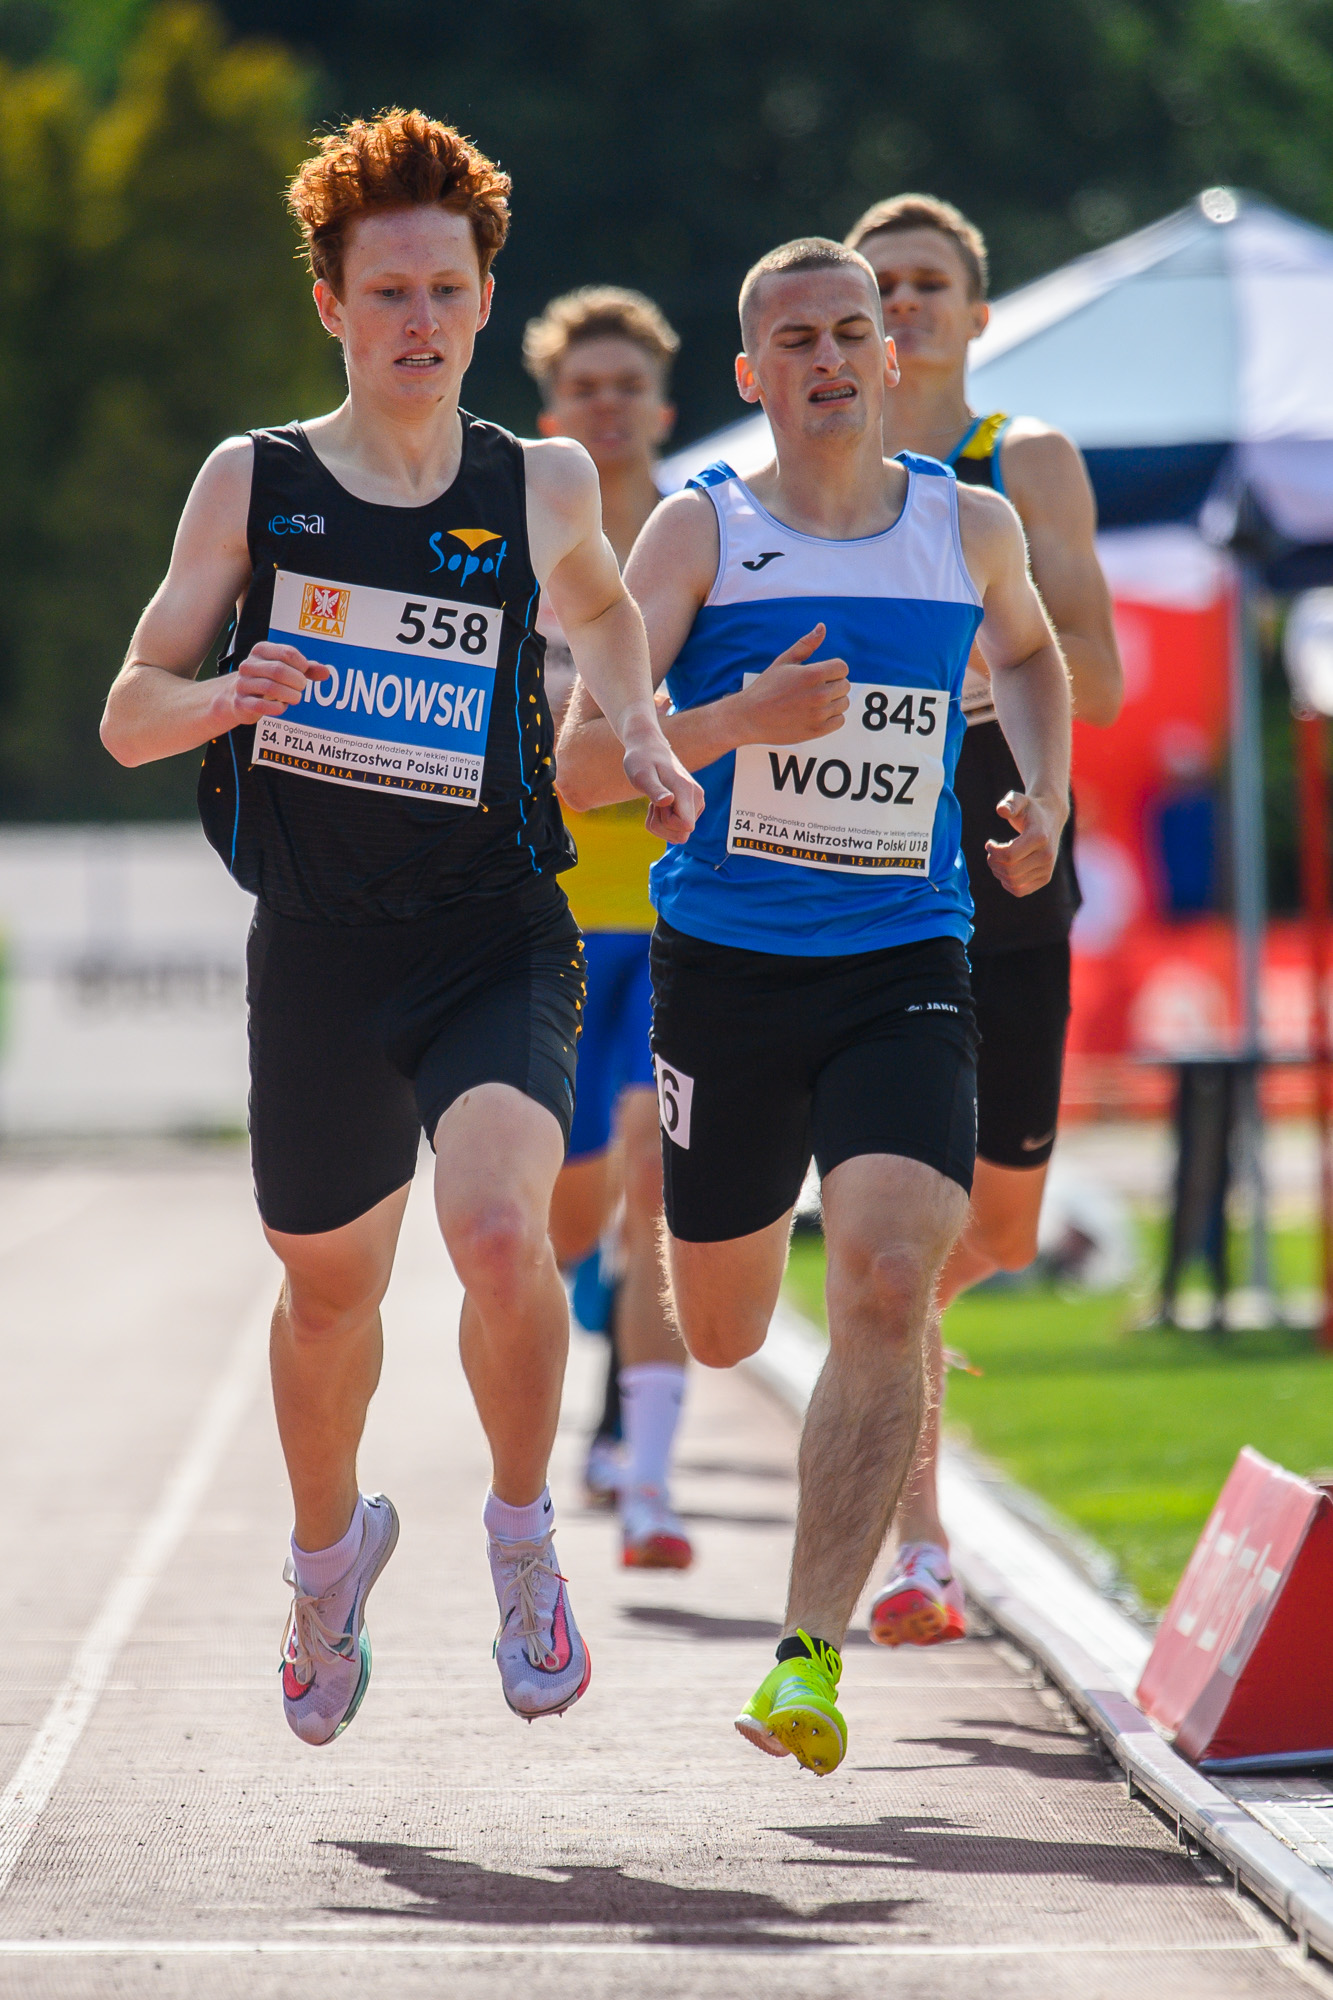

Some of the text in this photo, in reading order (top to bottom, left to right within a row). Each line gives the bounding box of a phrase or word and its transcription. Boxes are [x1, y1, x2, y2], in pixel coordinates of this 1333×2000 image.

[268, 514, 326, 535] esa
[429, 531, 507, 587] Sopot
[301, 615, 341, 635] PZLA
[395, 601, 489, 656] 558
[303, 664, 486, 732] OJNOWSKI
[861, 691, 937, 736] 845
[261, 729, 479, 782] 54. PZLA Mistrzostwa Polski U18
[262, 720, 282, 730] XXVIII
[283, 724, 332, 742] Ogólnopolska
[333, 736, 374, 750] Olimpiada
[375, 744, 414, 757] Młodzieży
[423, 751, 448, 762] lekkiej
[449, 756, 481, 767] atletyce
[262, 750, 472, 798] BIELSKO-BIAŁA 15-17.07.2022
[768, 751, 919, 805] WOJSZ
[734, 818, 928, 852] 54. PZLA Mistrzostwa Polski U18
[735, 809, 755, 818] XXVIII
[757, 812, 805, 828] Ogólnopolska
[806, 821, 845, 833] Olimpiada
[847, 826, 882, 836] Młodzieży
[736, 838, 827, 862] BIELSKO-BIAŁA
[661, 1069, 680, 1132] 6
